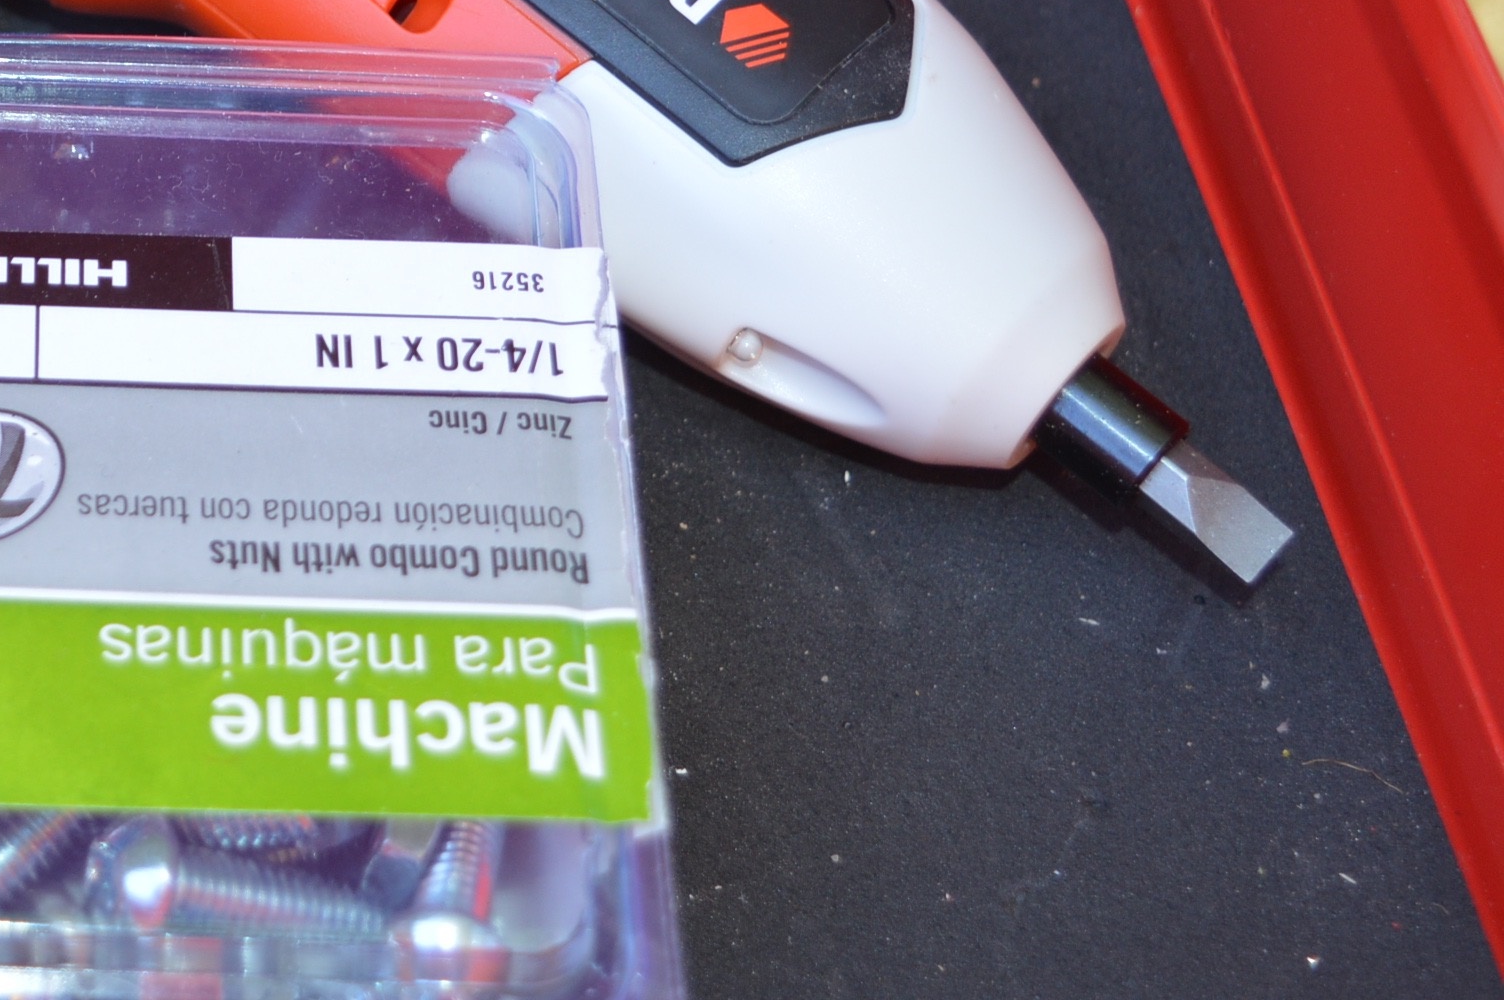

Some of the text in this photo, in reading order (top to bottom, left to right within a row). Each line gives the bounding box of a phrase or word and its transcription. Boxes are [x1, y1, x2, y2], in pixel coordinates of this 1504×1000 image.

[472, 271, 544, 293] 35216
[315, 334, 353, 368] IN
[374, 335, 388, 369] 1
[402, 336, 423, 362] x
[428, 410, 487, 435] Cinc
[517, 411, 572, 439] Zinc
[77, 493, 585, 538] Combinación redonda con tuercas
[210, 539, 589, 584] Round Combo with Nuts
[98, 617, 599, 695] Para máquinas
[210, 693, 606, 779] Machine
